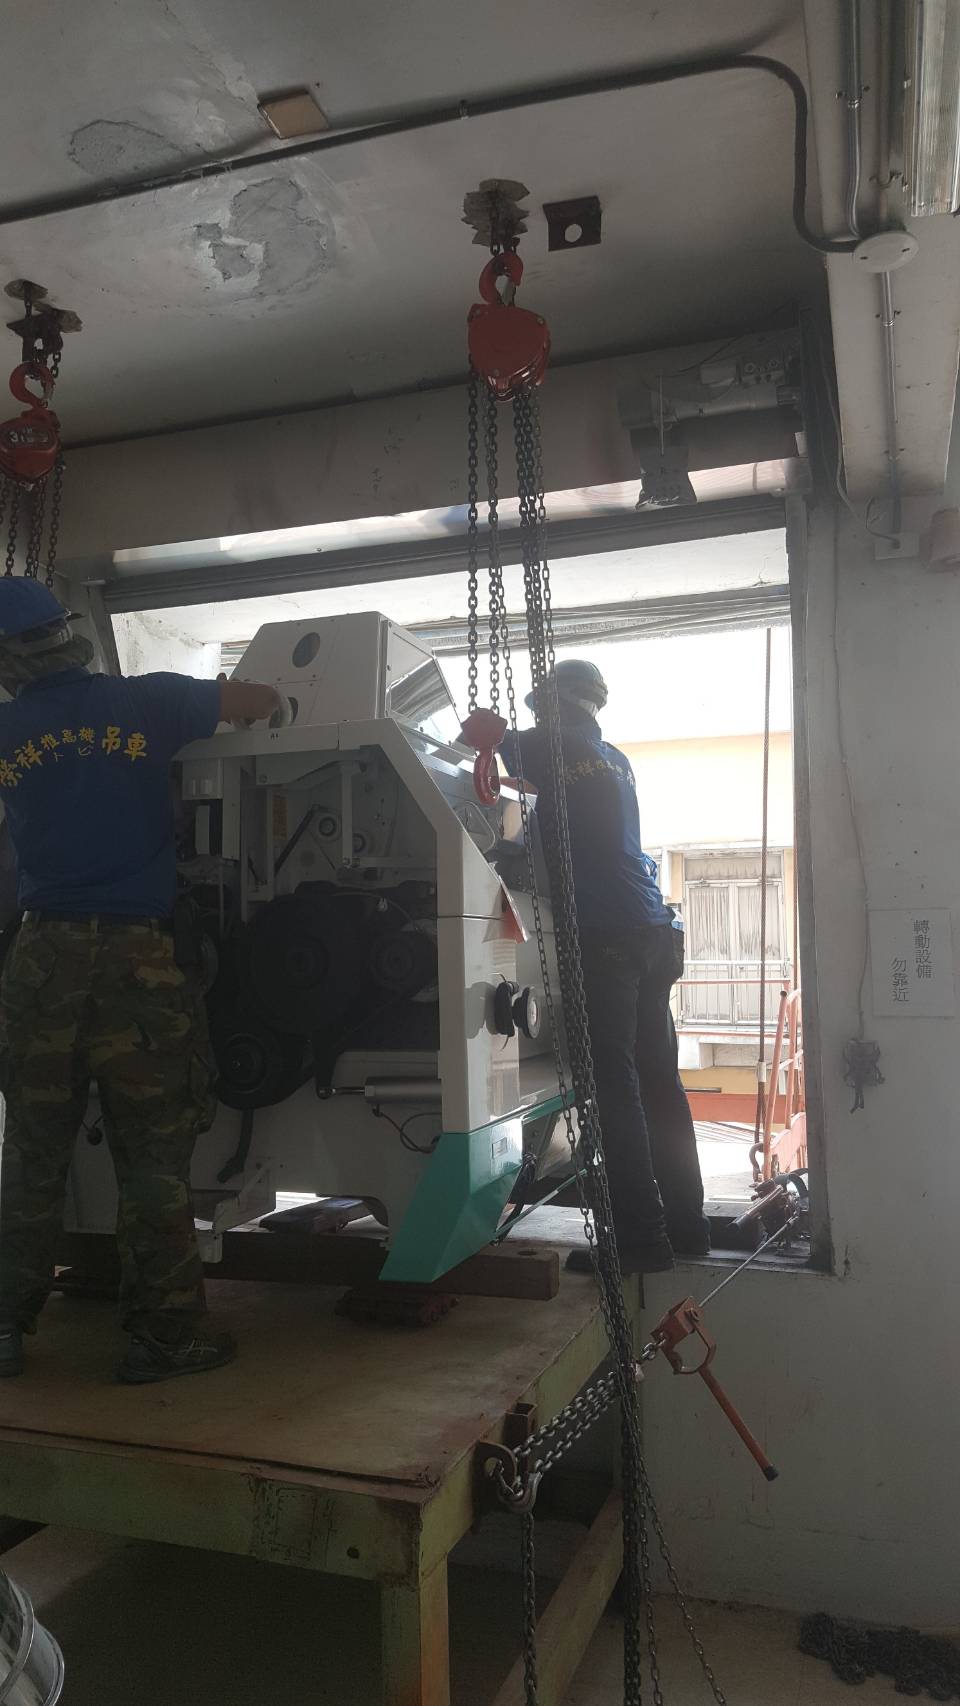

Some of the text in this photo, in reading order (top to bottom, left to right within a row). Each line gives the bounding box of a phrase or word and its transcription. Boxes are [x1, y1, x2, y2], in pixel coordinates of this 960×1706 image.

[914, 919, 932, 978] 轉動設備
[891, 957, 910, 1001] 勿靠近
